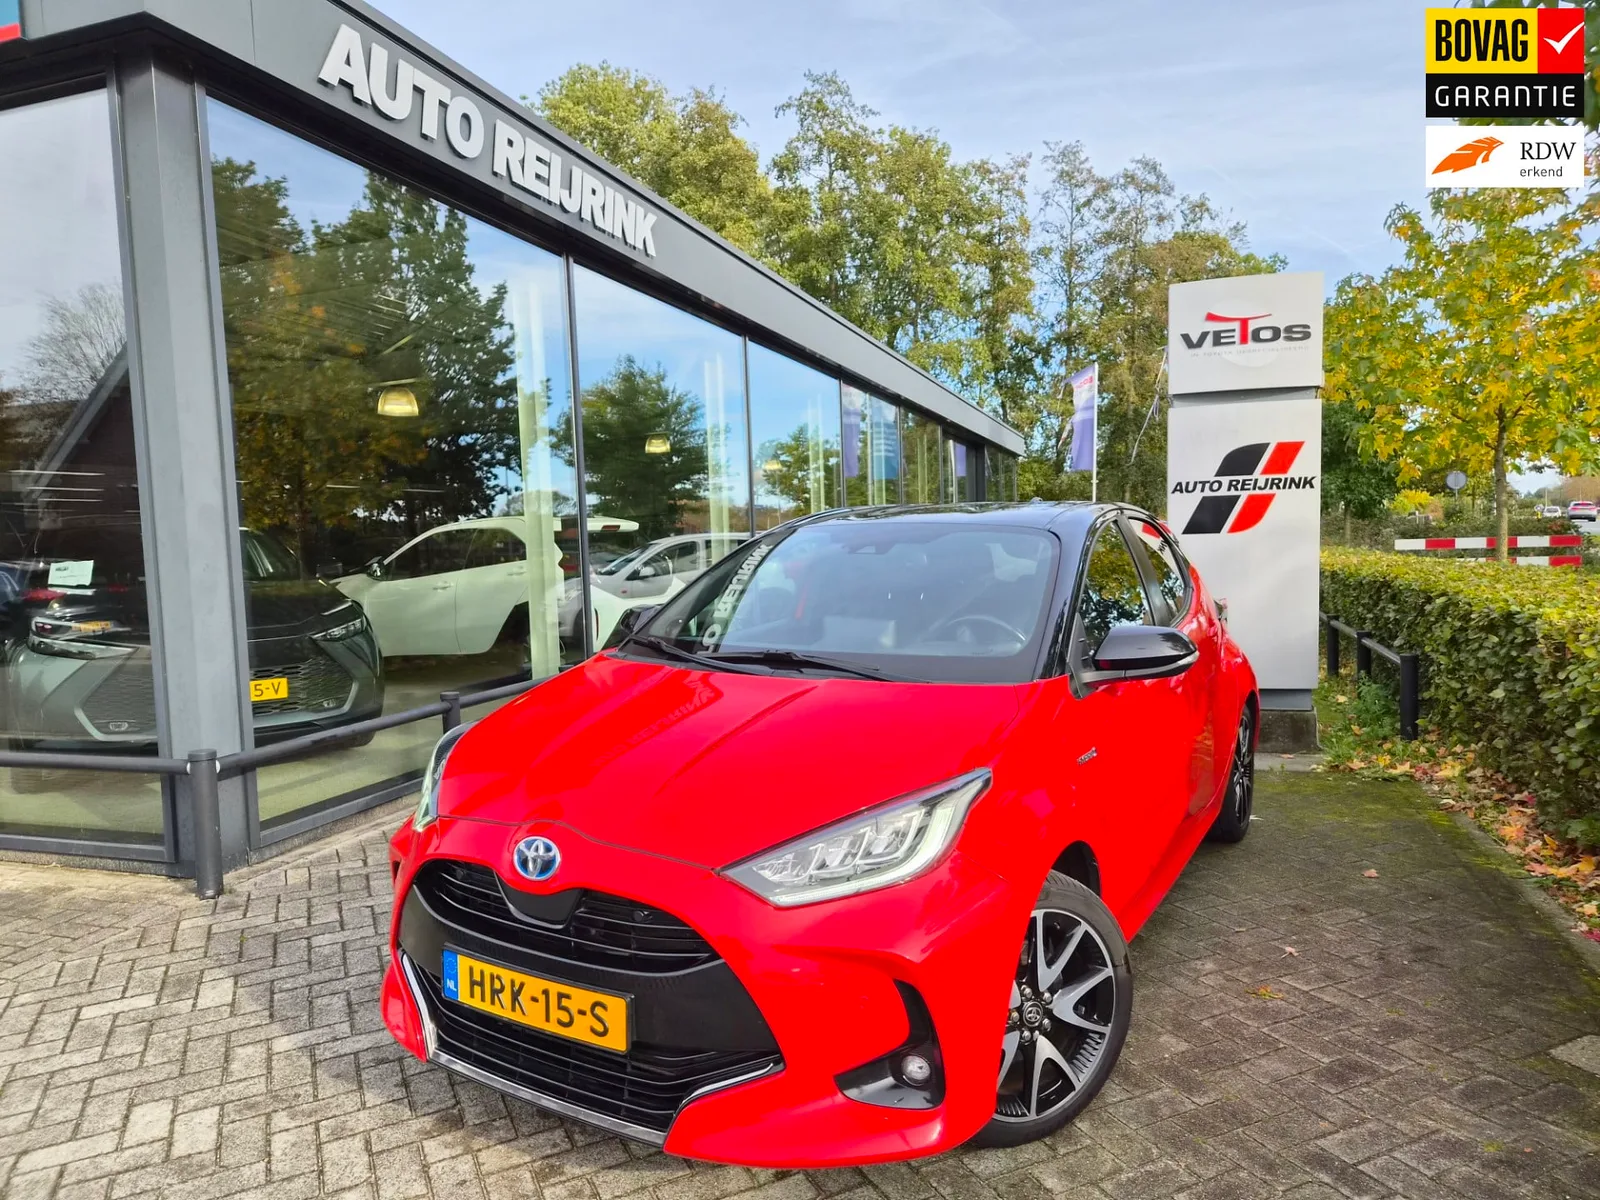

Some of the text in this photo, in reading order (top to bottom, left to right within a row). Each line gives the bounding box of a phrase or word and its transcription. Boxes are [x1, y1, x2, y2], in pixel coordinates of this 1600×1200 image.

[318, 24, 657, 257] AUTO REIJRINK
[1180, 312, 1311, 350] VETOS
[1171, 476, 1316, 494] AUTO REIJRINK
[253, 682, 281, 697] 5-V
[446, 977, 457, 992] NL
[469, 965, 609, 1038] HRK-15-S
